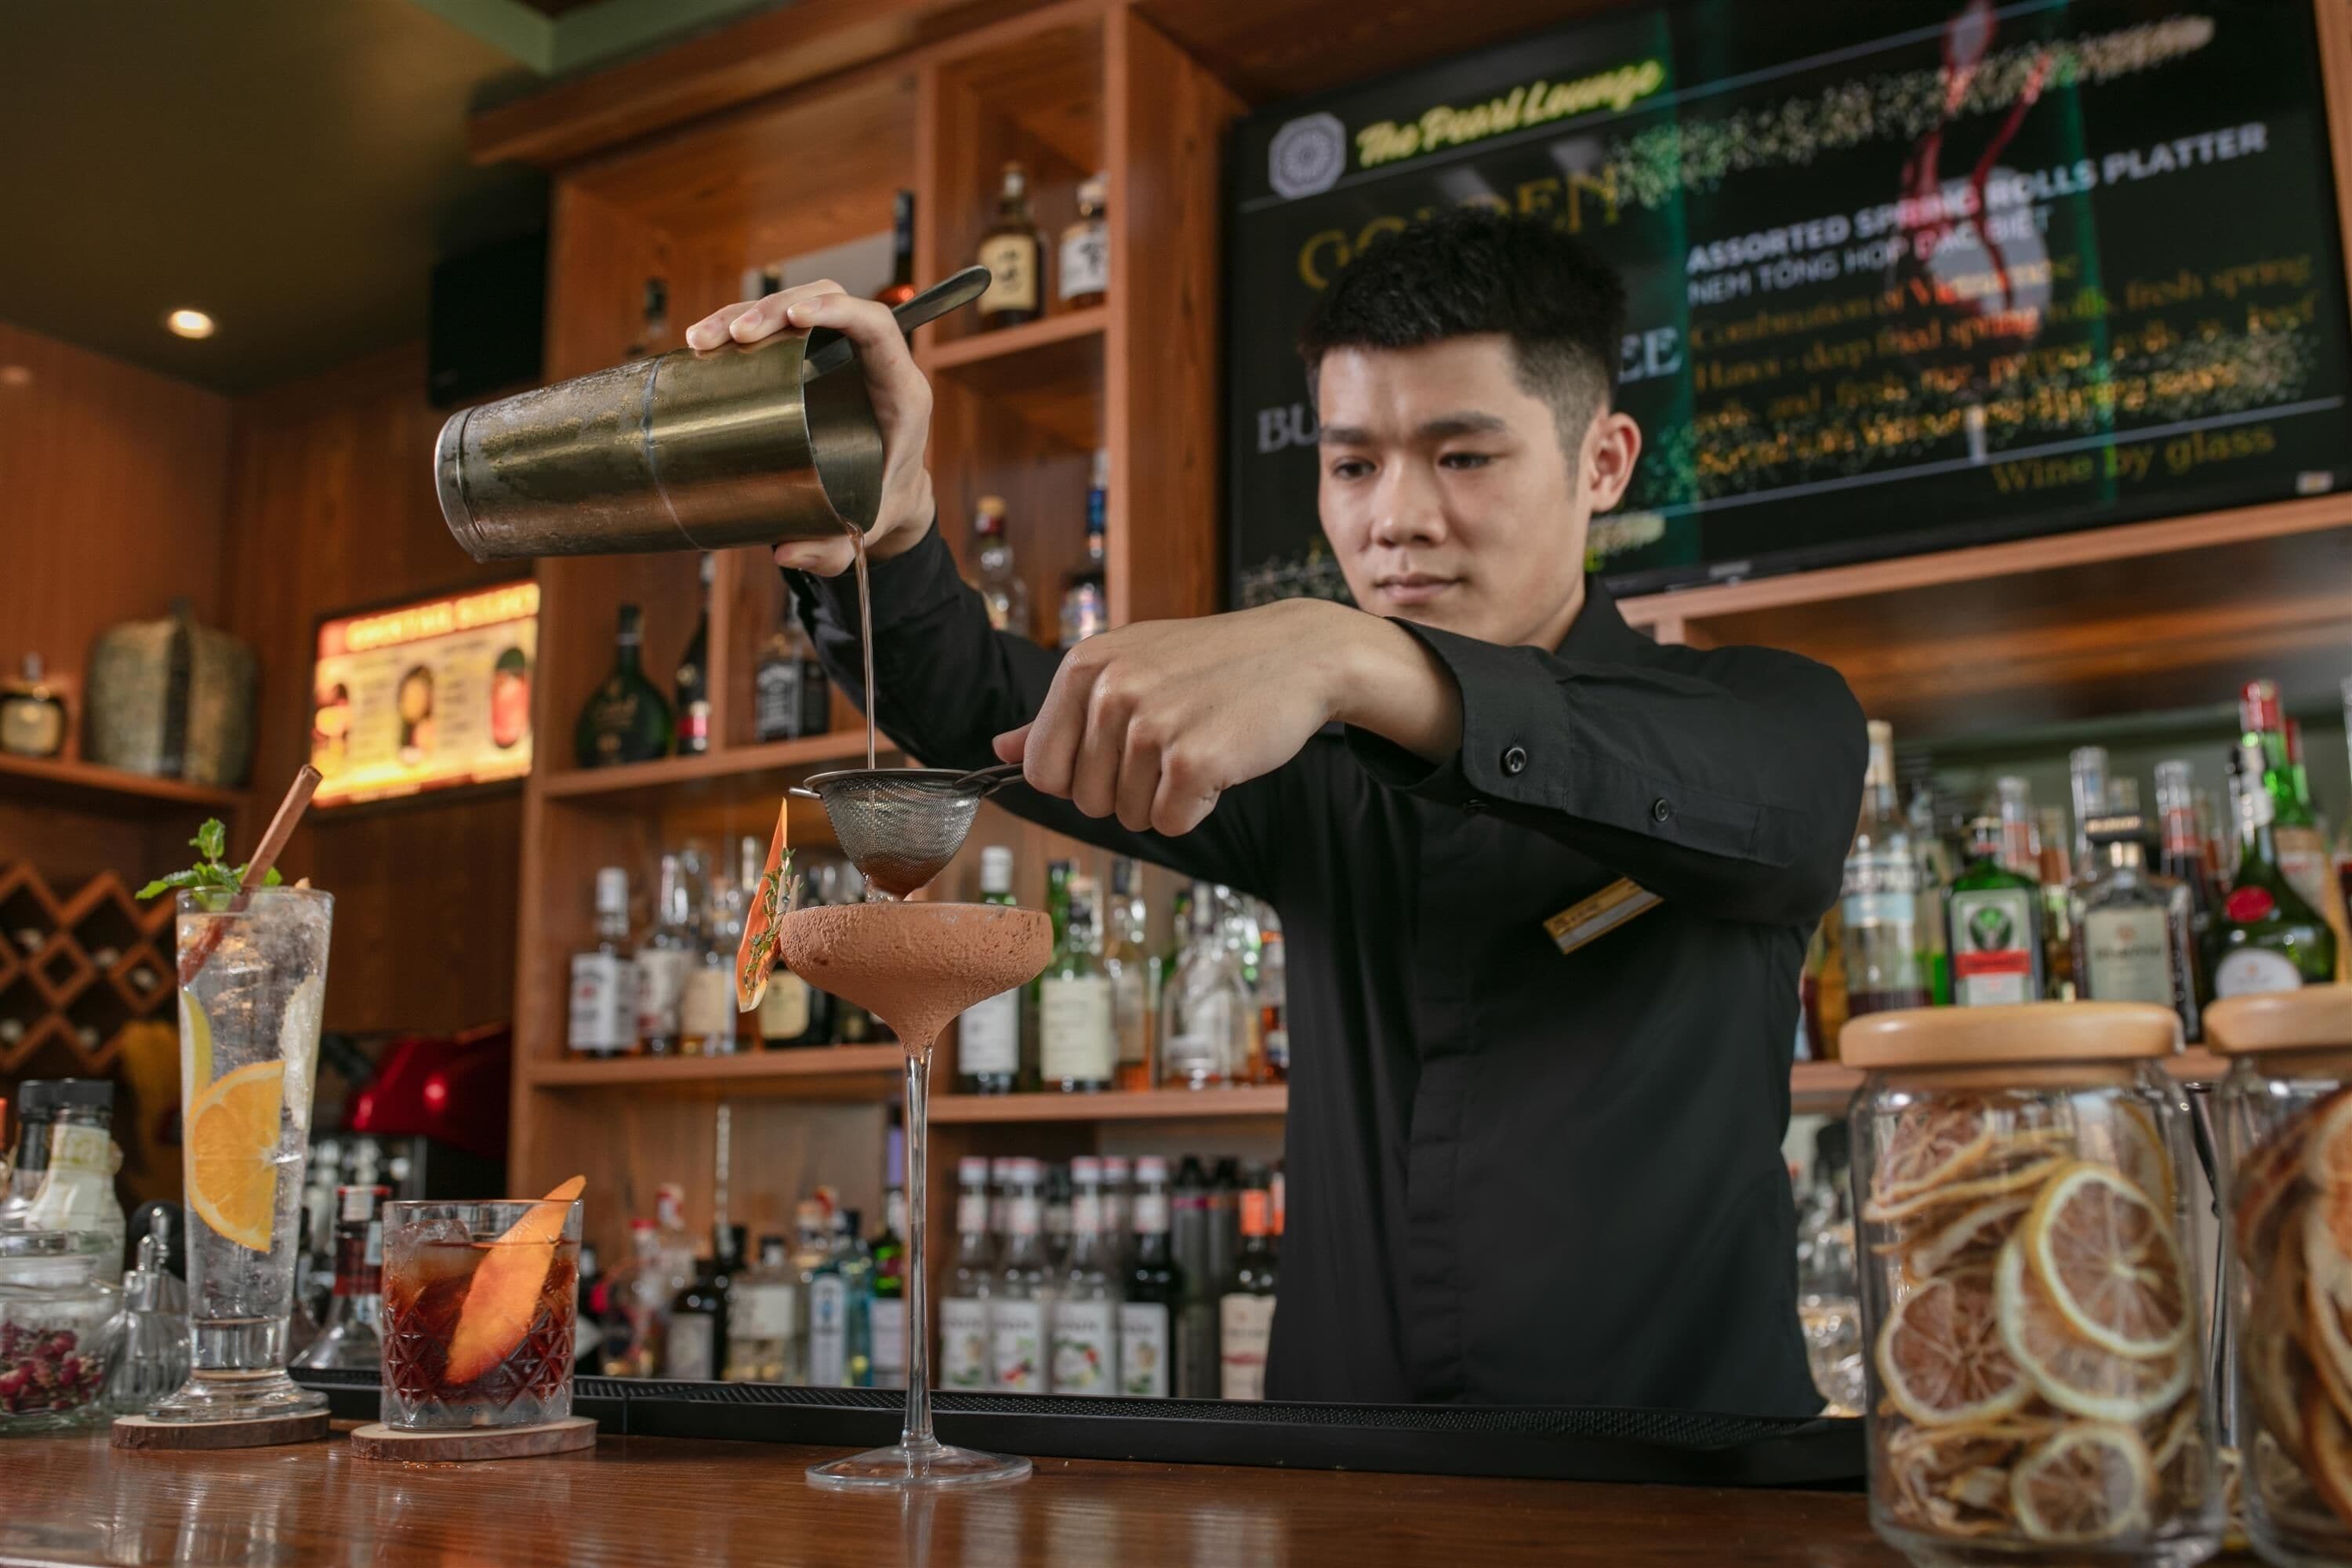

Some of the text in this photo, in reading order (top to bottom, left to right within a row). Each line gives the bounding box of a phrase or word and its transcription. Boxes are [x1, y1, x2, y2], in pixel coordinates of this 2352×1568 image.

[1523, 60, 1663, 112] Lounge
[1686, 122, 2268, 274] ASSORTED SPRING ROLLS PLATTER
[1991, 423, 2277, 494] Wine by glass
